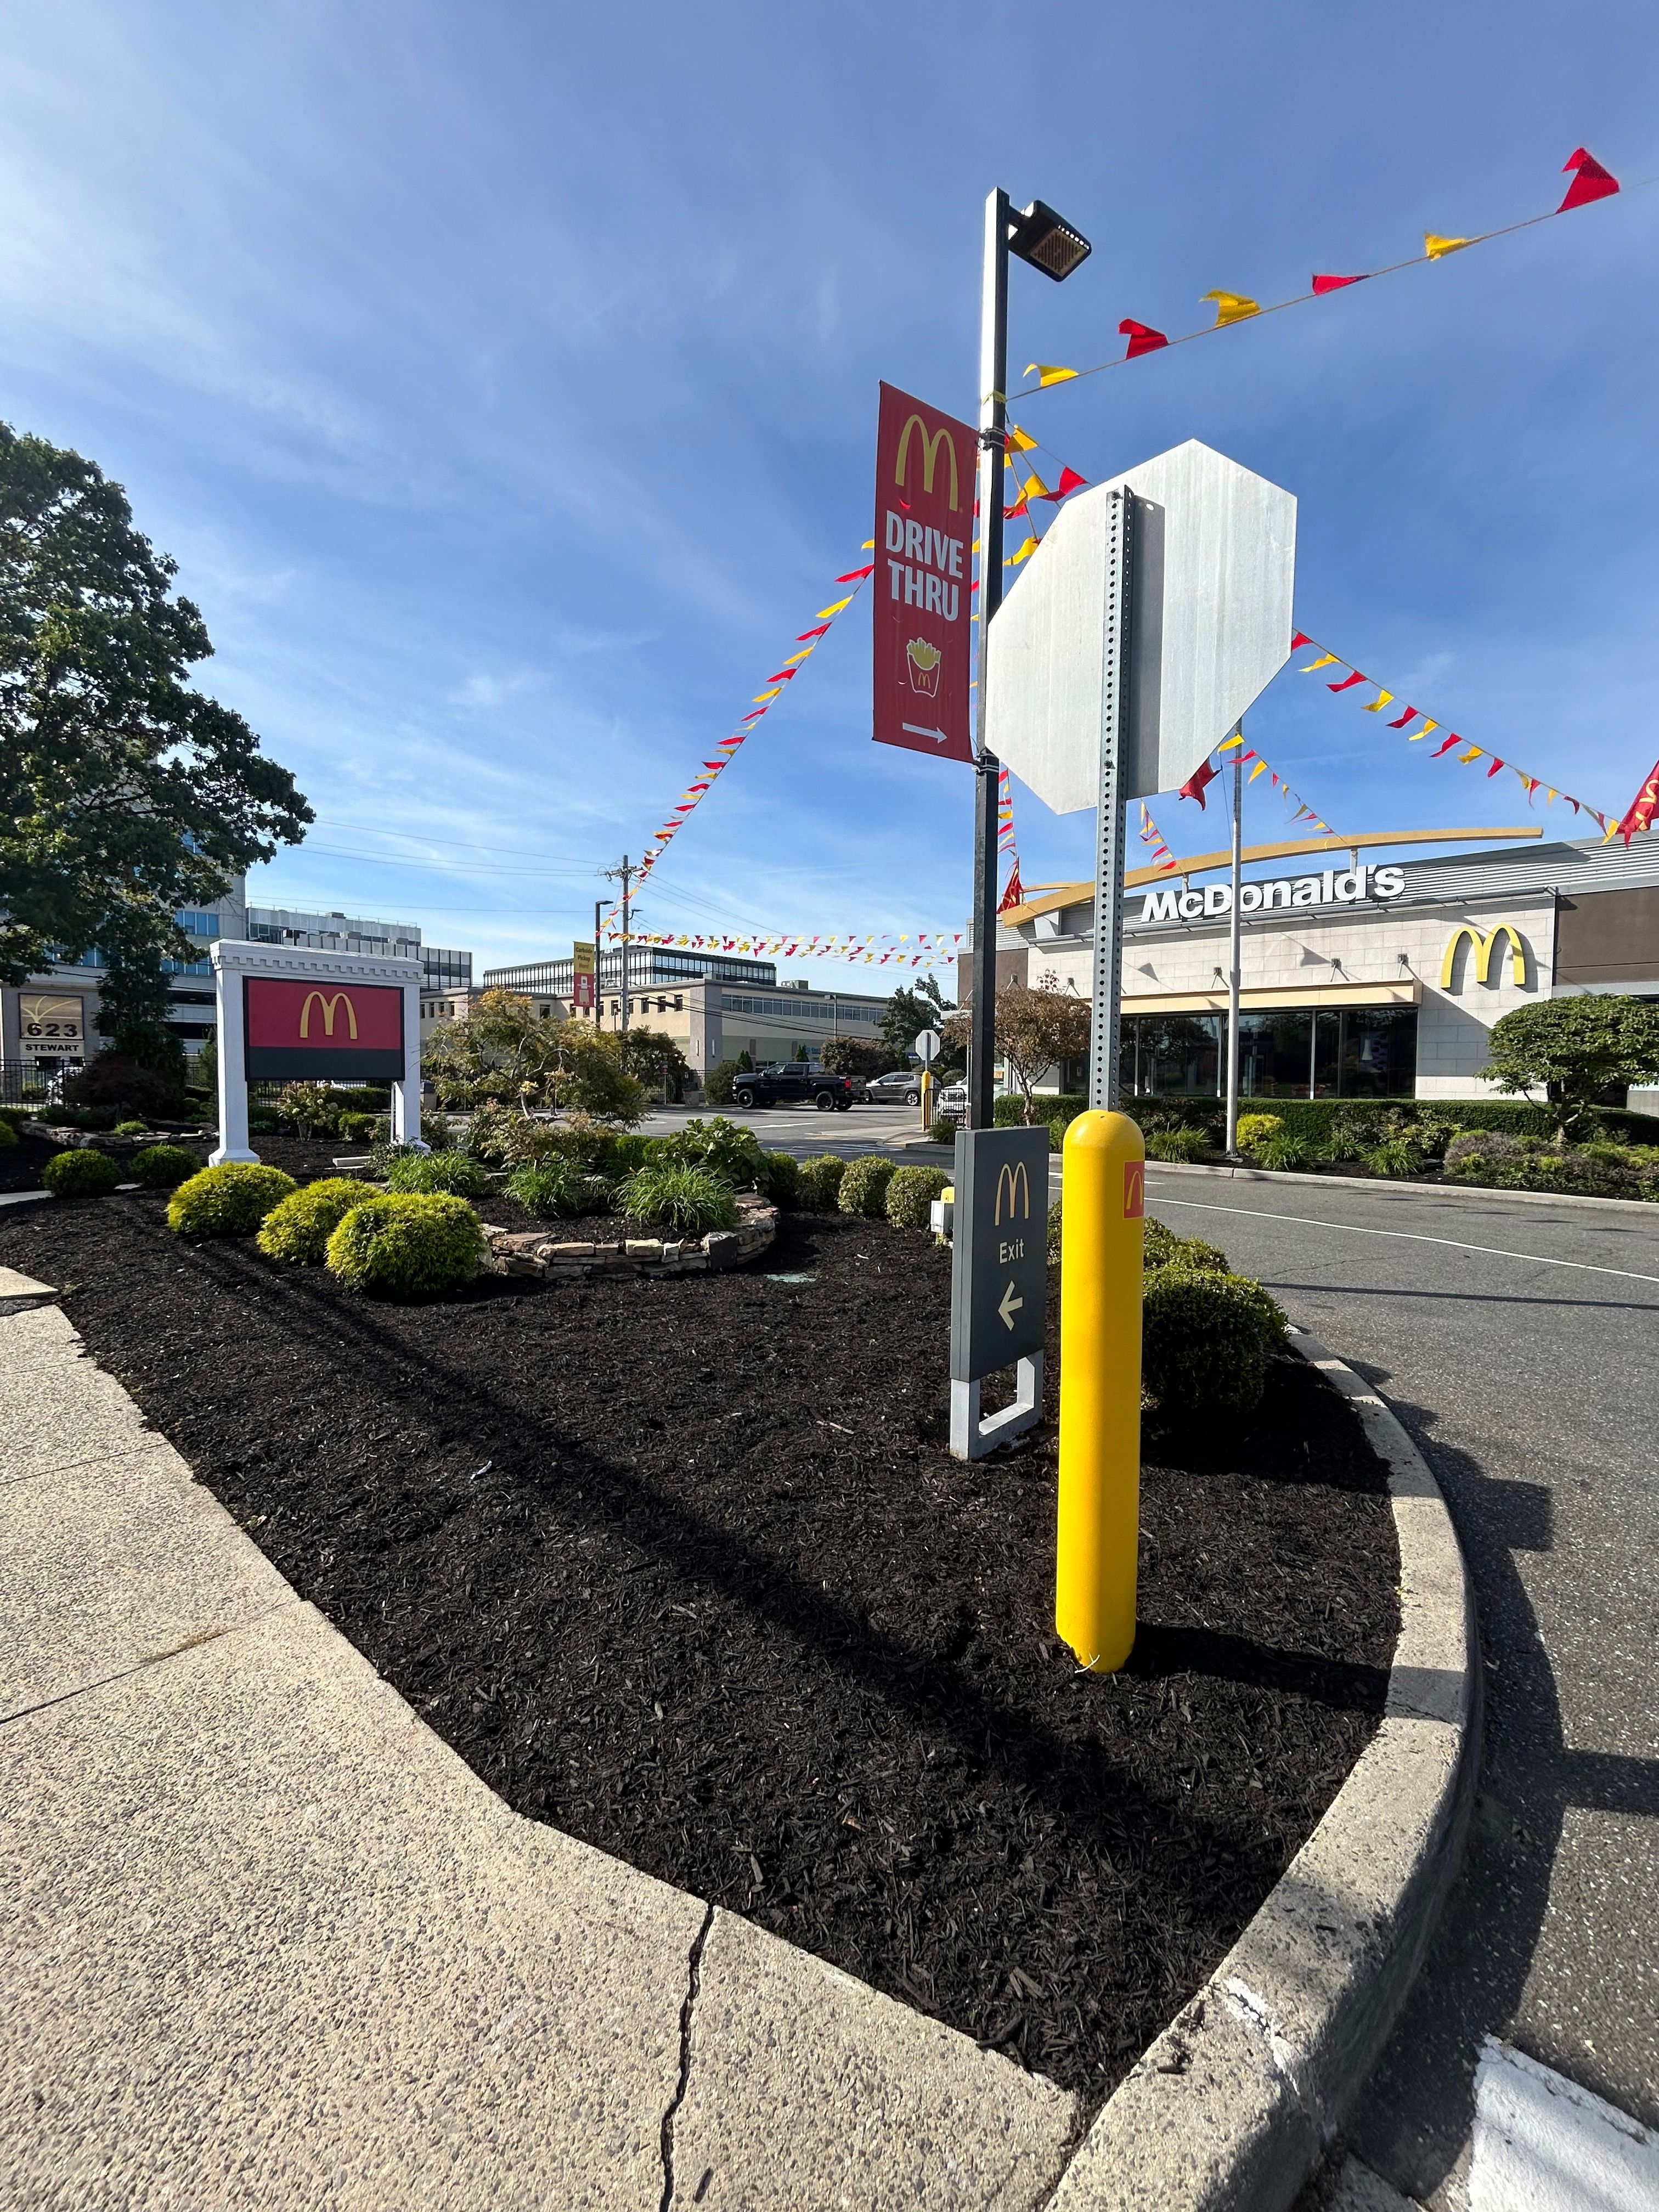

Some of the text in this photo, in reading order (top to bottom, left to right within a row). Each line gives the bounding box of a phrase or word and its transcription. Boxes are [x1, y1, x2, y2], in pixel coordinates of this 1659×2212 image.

[886, 510, 963, 579] DRIVE
[887, 558, 959, 622] THRU
[1141, 864, 1406, 922] McDonald's
[25, 1043, 79, 1052] STEWART
[27, 1023, 77, 1037] 623
[1000, 1238, 1024, 1263] Exit
